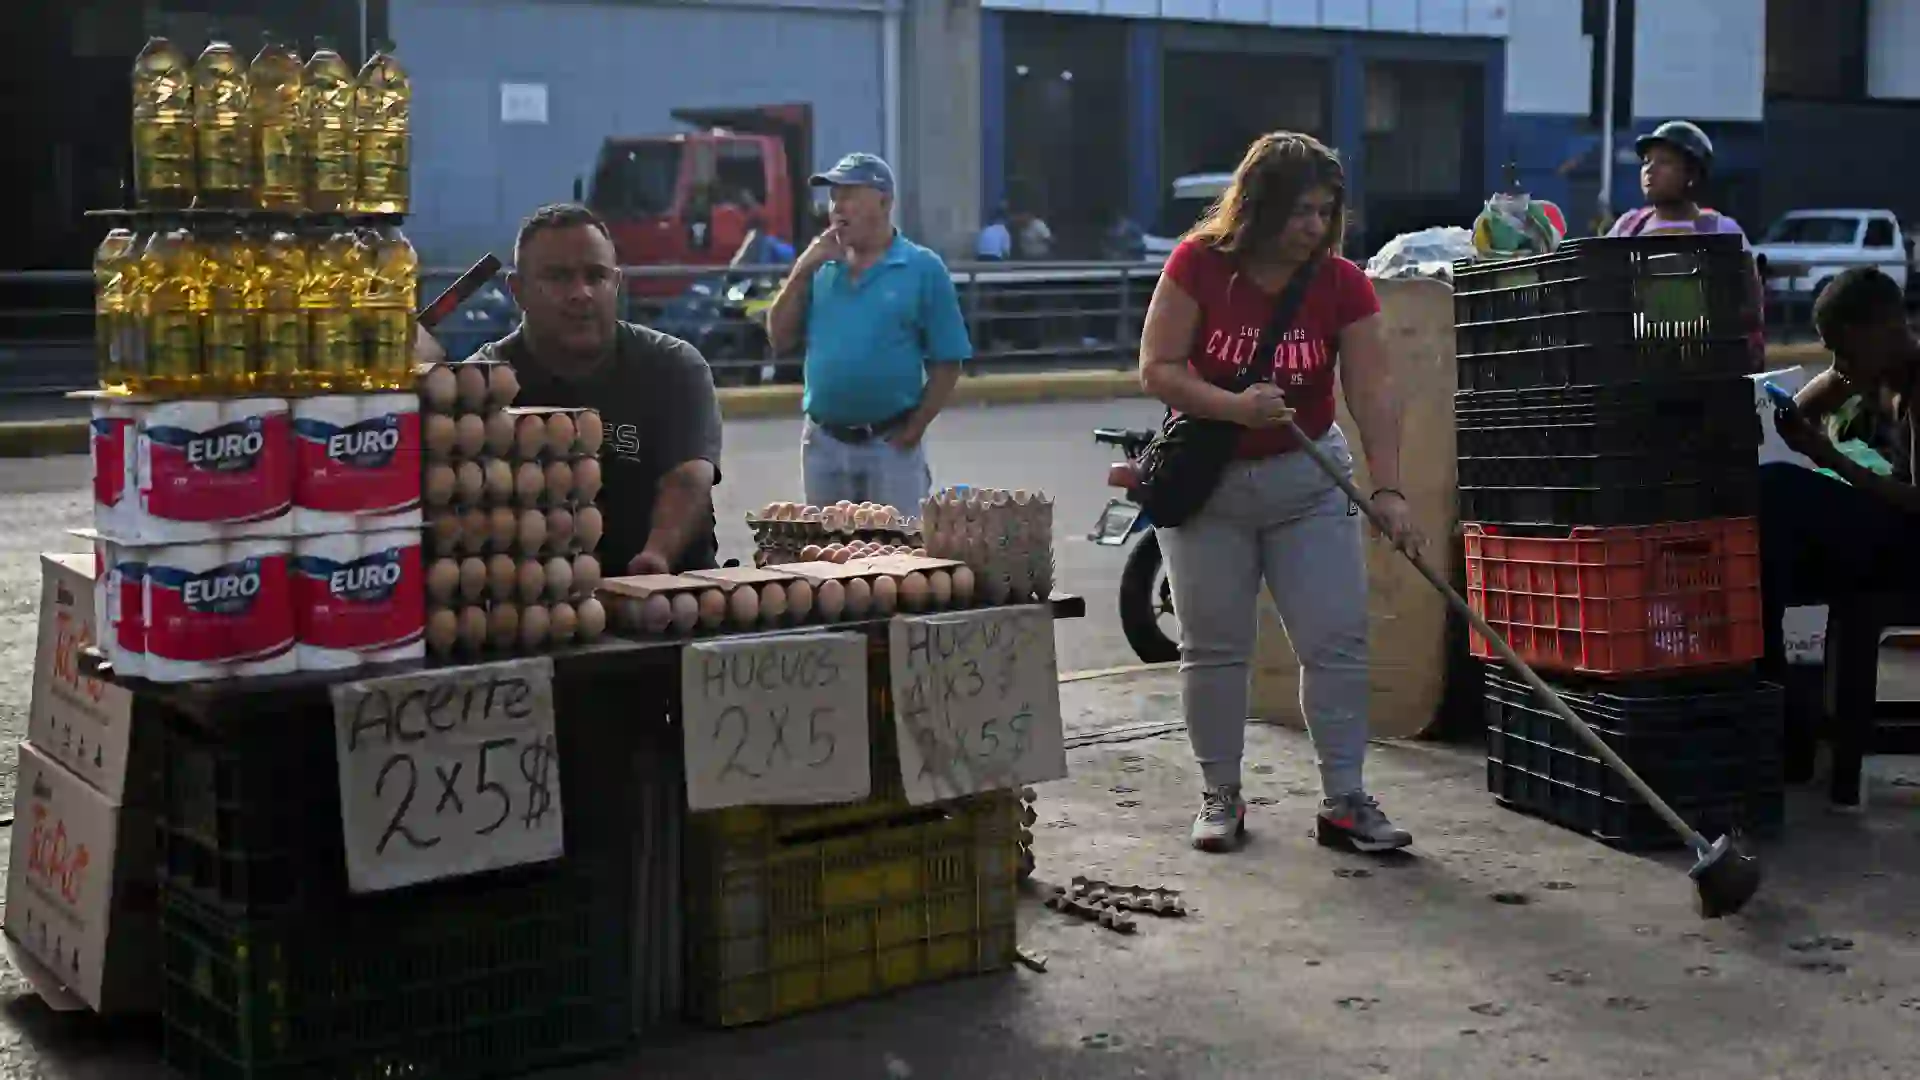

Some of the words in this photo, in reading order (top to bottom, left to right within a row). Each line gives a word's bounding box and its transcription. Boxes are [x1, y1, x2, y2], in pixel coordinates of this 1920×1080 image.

[187, 432, 264, 463] EURO
[328, 427, 399, 458] EURO
[183, 573, 260, 604] EURO
[330, 563, 401, 594] EURO
